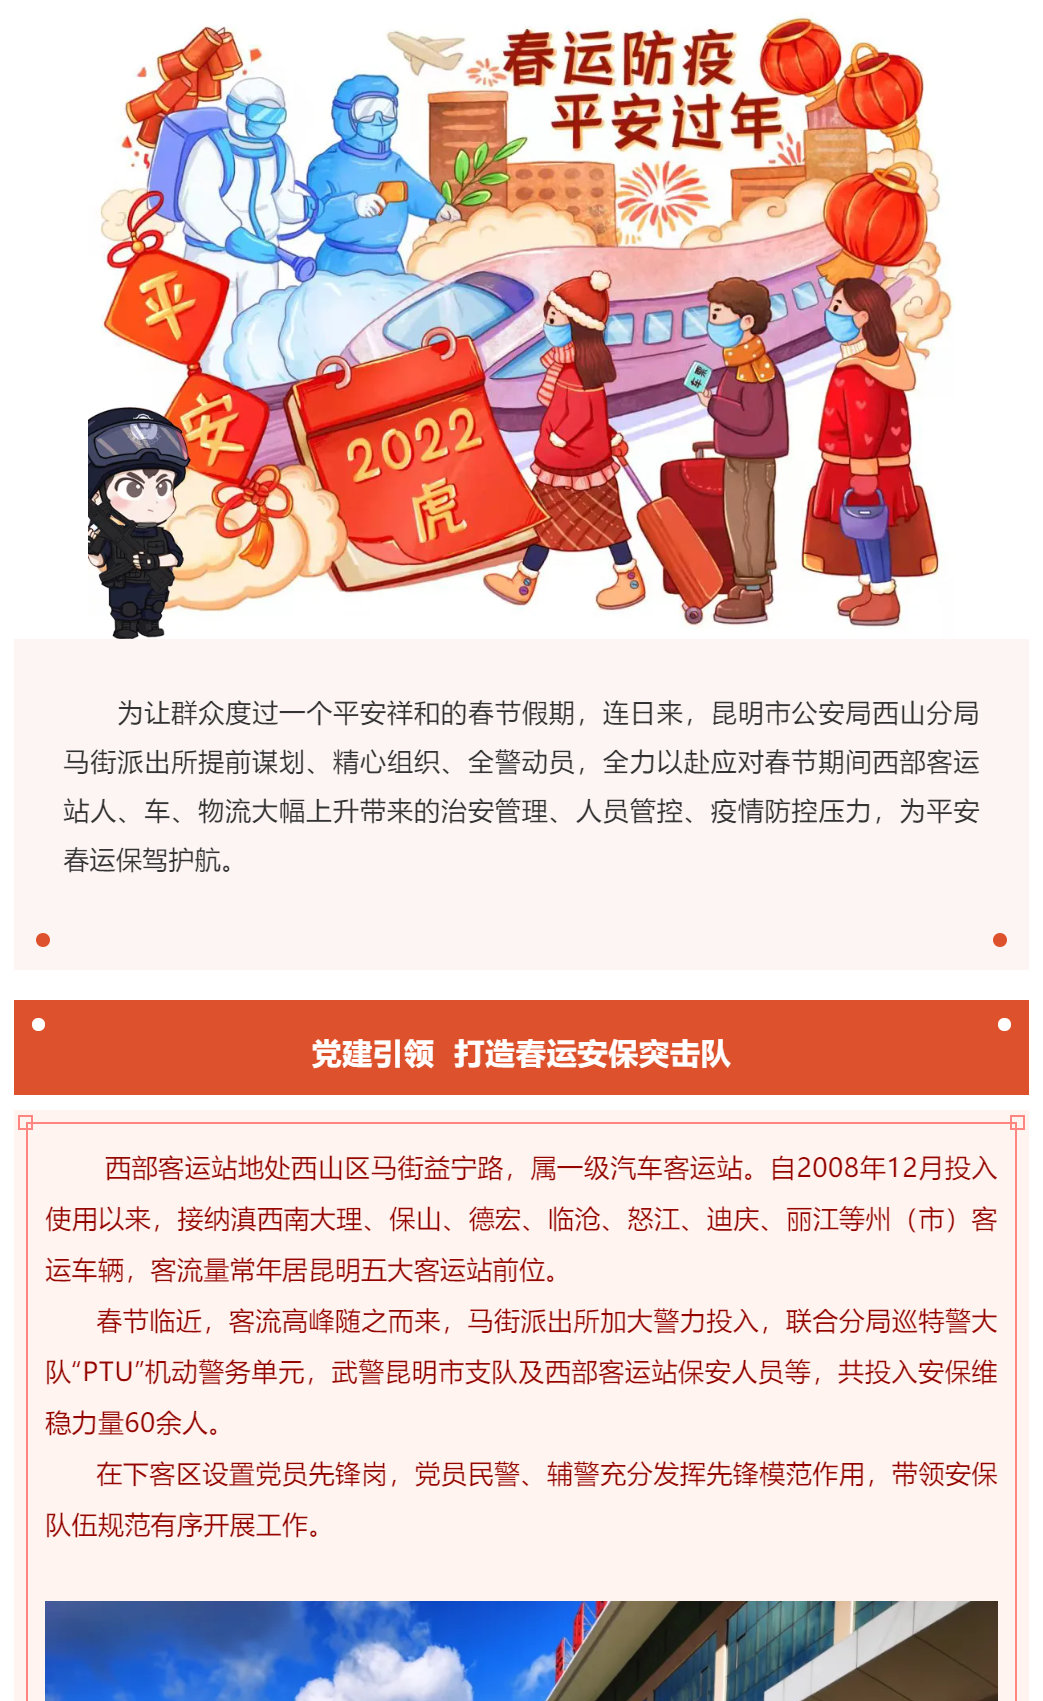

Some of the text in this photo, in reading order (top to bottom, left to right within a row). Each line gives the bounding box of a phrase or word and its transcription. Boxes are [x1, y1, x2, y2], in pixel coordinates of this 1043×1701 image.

[503, 29, 737, 88] 春运防疫
[551, 92, 784, 151] 平安过年
[138, 272, 198, 342] 平
[181, 393, 245, 467] 安
[346, 407, 484, 482] 2022
[411, 479, 469, 545] 虎
[118, 699, 980, 727] 为让群众度过一个平安祥和的春节假期，连日来，昆明市公安局西山分局
[63, 748, 980, 776] 马街派出所提前谋划、精心组织、全警动员，全力以赴应对春节期间西部客运
[63, 797, 980, 825] 站人、车、物流大幅上升带来的治安管理、人员管控、疫情防控压力，为平安
[63, 846, 234, 873] 春运保驾护航。
[312, 1038, 732, 1069] 党建引领 打造春运安保突击队
[105, 1154, 998, 1182] 西部客运站地处西山区马街益宁路，属一级汽车客运站。自2008年12月投入
[45, 1256, 556, 1284] 运车辆，客流量常年居昆明五大客运站前位。
[96, 1307, 998, 1335] 春节临近，客流高峰随之而来，马街派出所加大警力投入，联合分局巡特警大
[45, 1409, 220, 1436] 稳力量60余人。
[96, 1460, 998, 1488] 在下客区设置党员先锋岗，党员民警、辅警充分发挥先锋模范作用，带领安保
[46, 1511, 320, 1539] 队伍规范有序开展工作。
